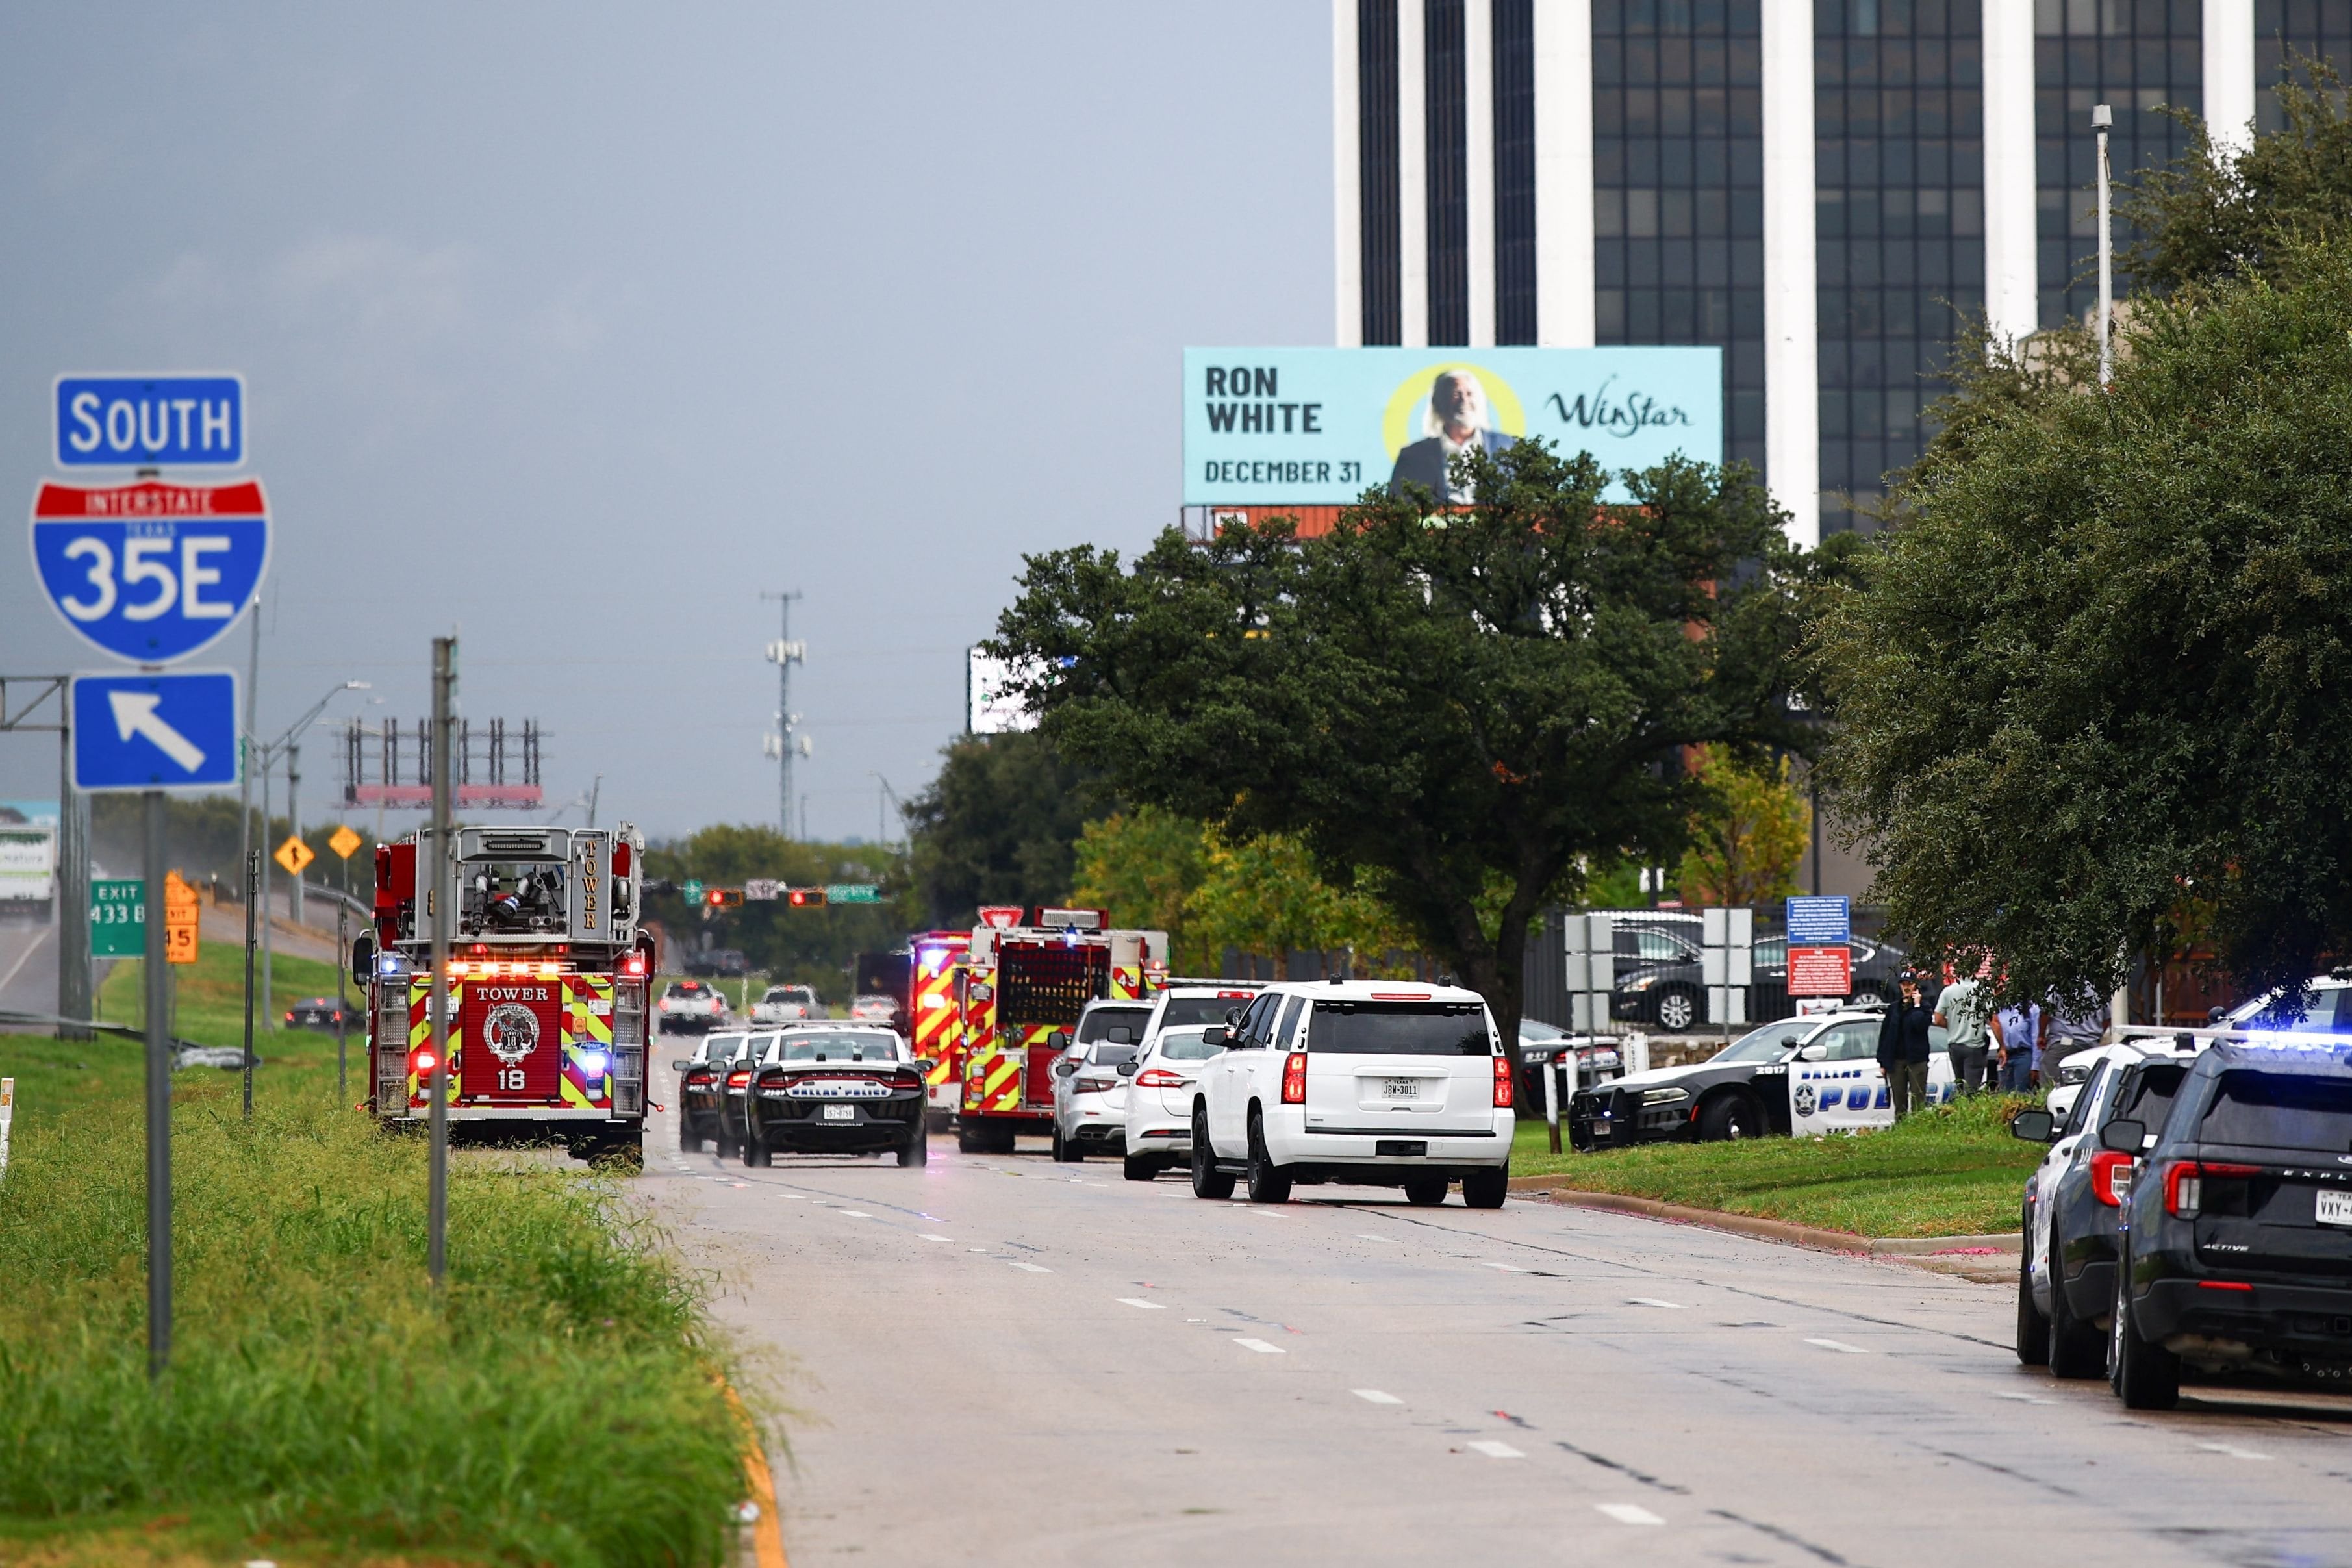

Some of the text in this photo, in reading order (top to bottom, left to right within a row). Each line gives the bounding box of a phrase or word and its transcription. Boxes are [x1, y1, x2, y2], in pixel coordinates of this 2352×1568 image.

[1206, 367, 1277, 397] RON
[1545, 373, 1695, 438] WinStar
[69, 392, 231, 452] SOUTH
[1206, 403, 1322, 433] WHITE
[1206, 461, 1361, 483] DECEMBER 31
[85, 490, 214, 515] INTERSTATE
[125, 521, 177, 538] TEXAS
[61, 536, 234, 622] 35E
[98, 885, 138, 900] EXIT
[583, 841, 599, 929] TOWER
[90, 904, 128, 924] 433
[1118, 976, 1136, 987] 43
[477, 987, 548, 1000] TOWER
[507, 1036, 516, 1046] 18
[498, 1069, 525, 1091] 18
[1756, 1065, 1786, 1075] 2017
[1801, 1070, 1862, 1080] DALLAS
[2283, 1170, 2347, 1180] EXPL
[2203, 1243, 2249, 1252] ACTIVE
